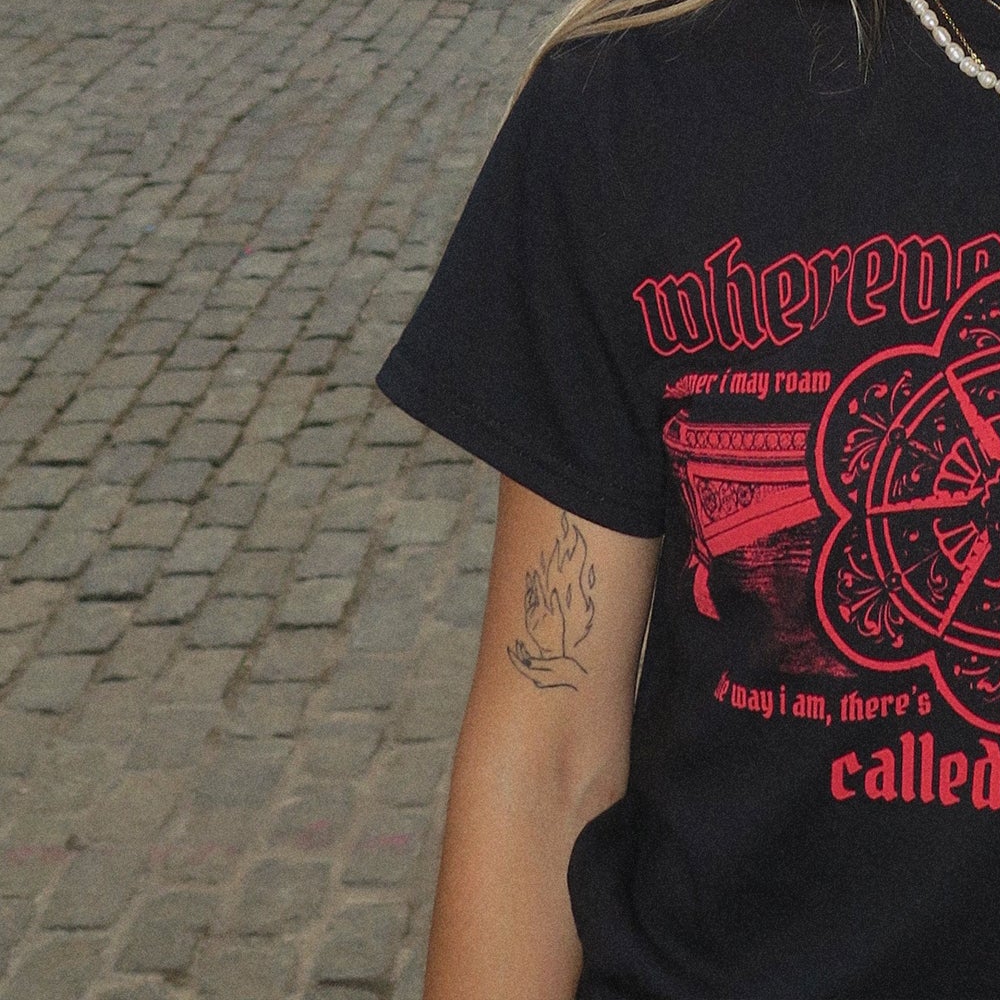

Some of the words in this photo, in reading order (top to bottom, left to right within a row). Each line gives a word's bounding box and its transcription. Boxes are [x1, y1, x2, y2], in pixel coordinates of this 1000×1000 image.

[730, 370, 770, 400] may
[775, 369, 832, 394] roam
[731, 683, 774, 719] way
[779, 684, 787, 716] i
[791, 691, 832, 727] am,
[840, 684, 932, 722] there's
